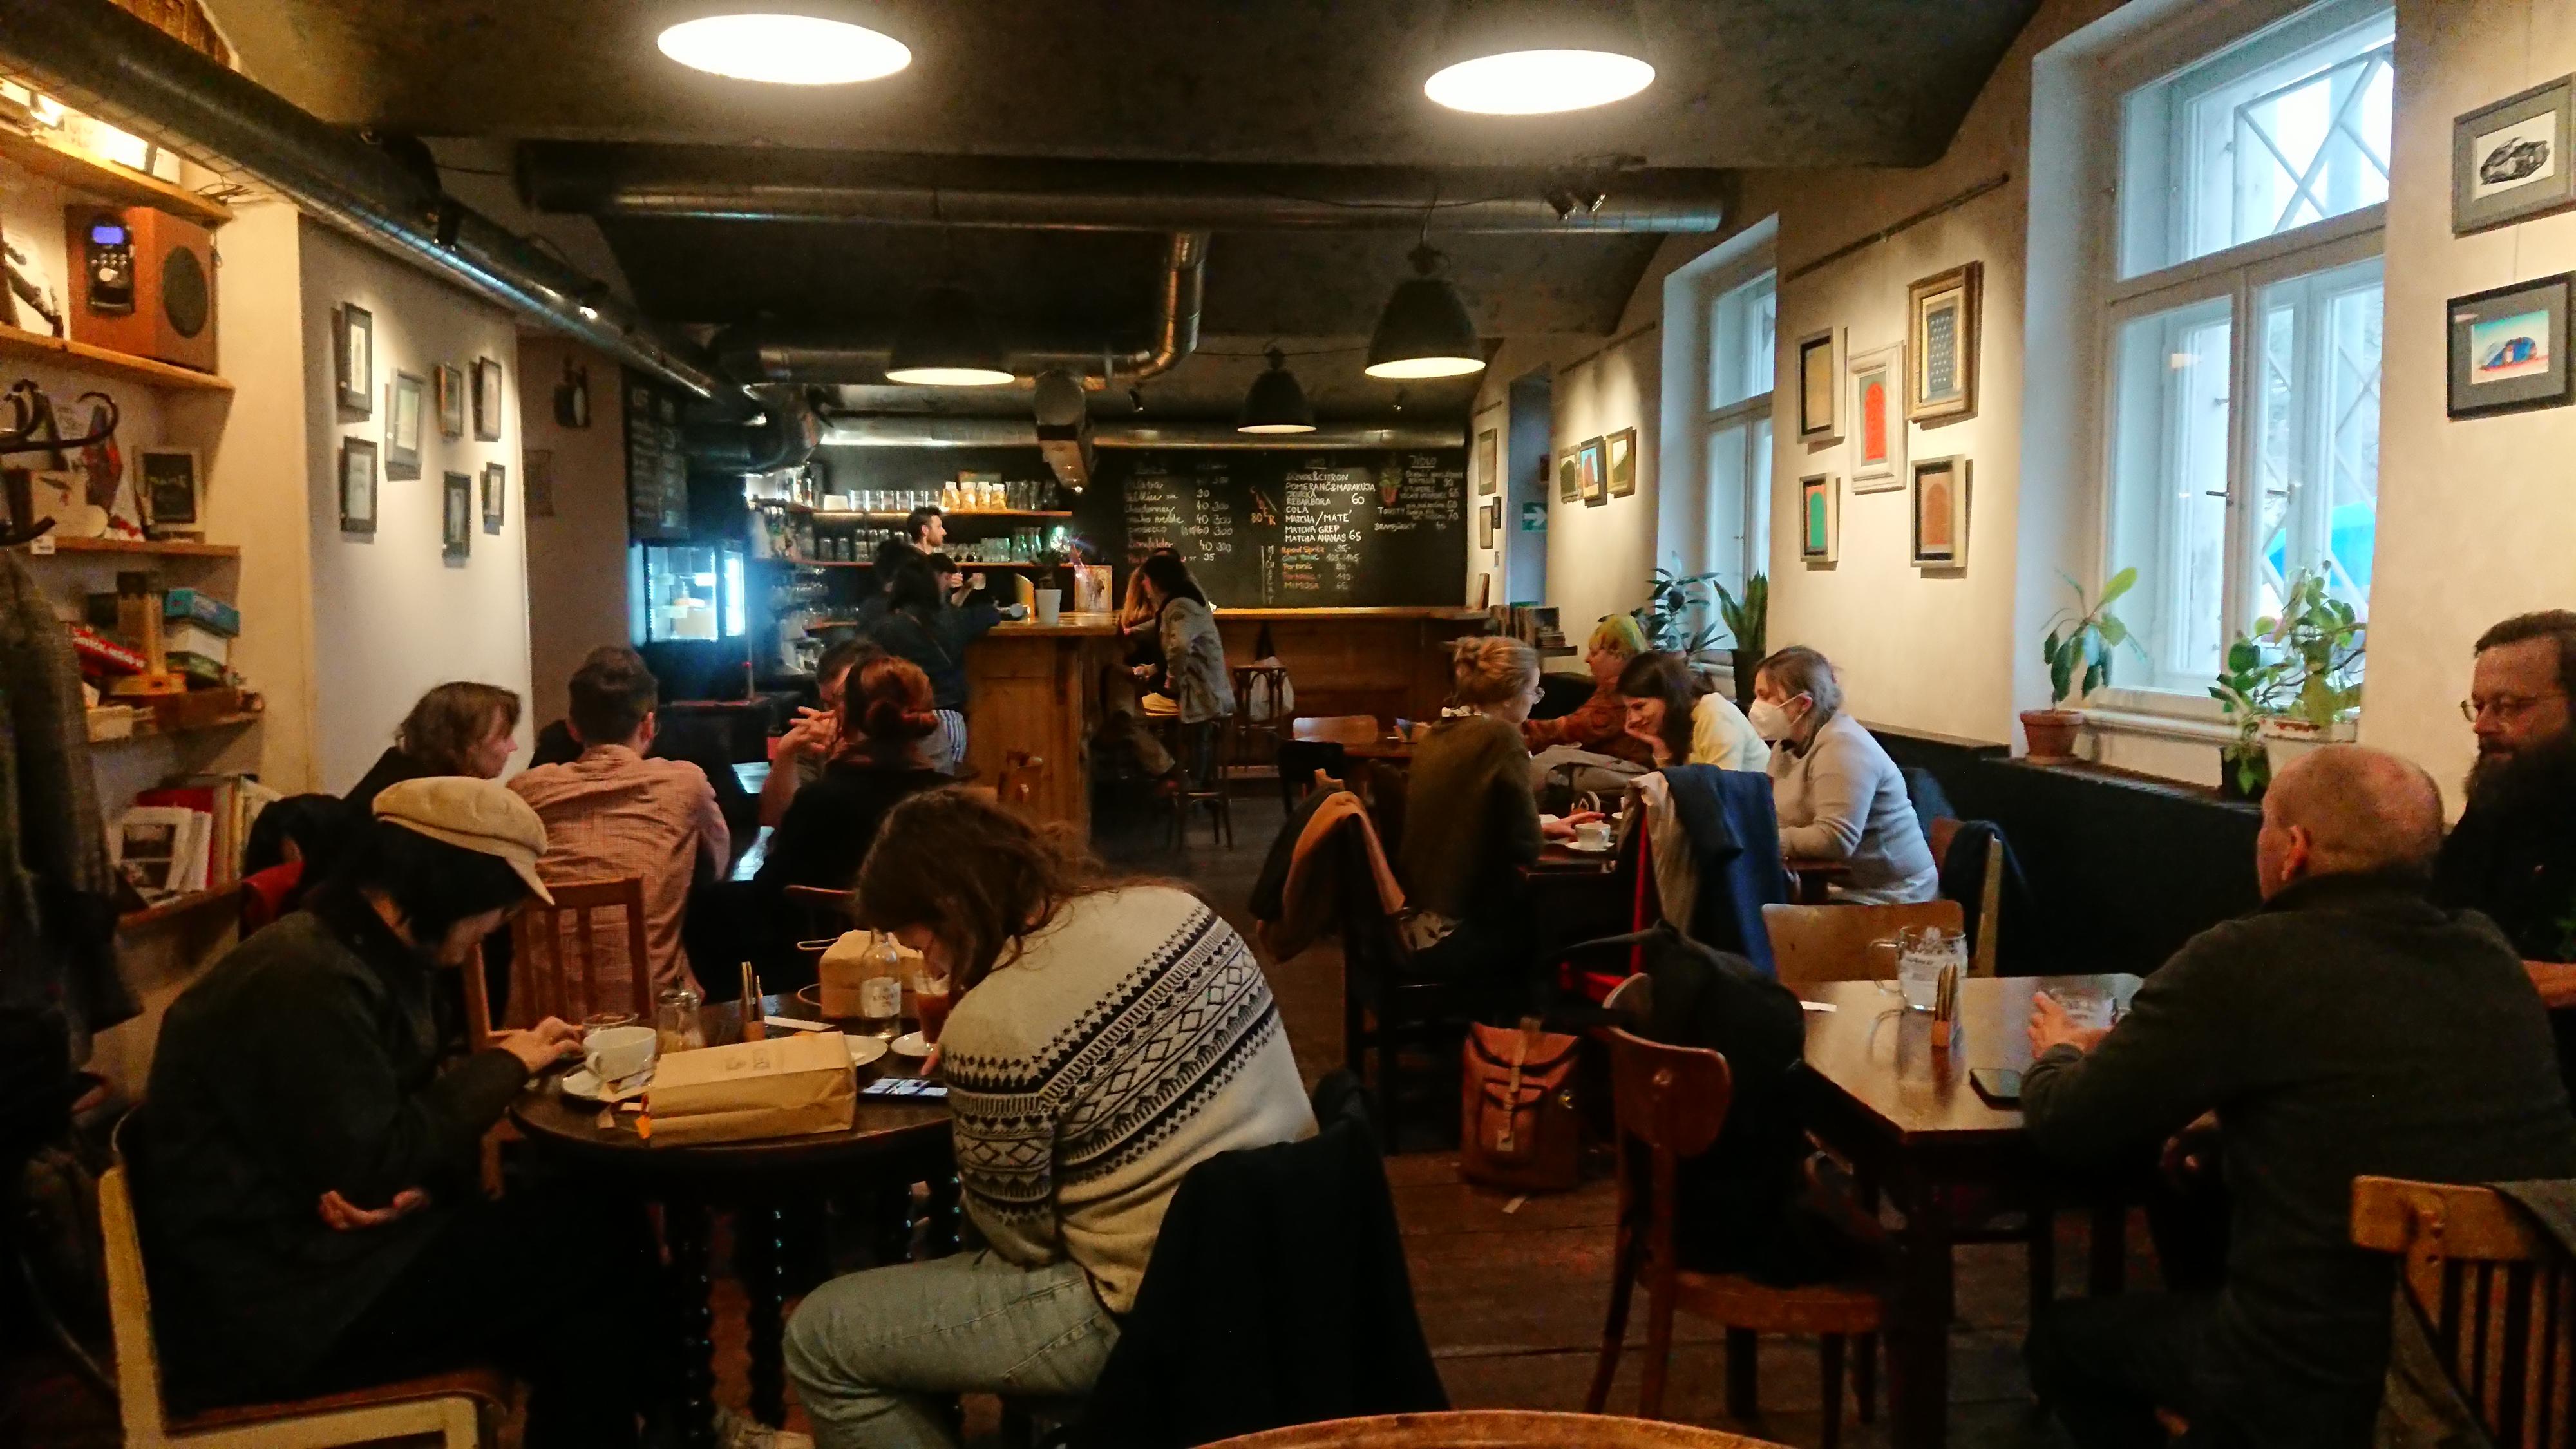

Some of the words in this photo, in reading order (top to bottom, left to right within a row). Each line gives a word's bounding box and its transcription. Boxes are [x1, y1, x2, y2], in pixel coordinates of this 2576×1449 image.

[1197, 489, 1210, 498] 30
[1351, 493, 1365, 504] 60
[1196, 500, 1210, 511] 40
[1211, 501, 1229, 512] 300
[1197, 513, 1209, 524] 40
[1213, 515, 1232, 525] 300
[1213, 527, 1233, 536] 300
[1285, 526, 1316, 534] MATCHA
[1318, 524, 1340, 533] GREP
[1317, 533, 1347, 542] ANANAS
[1349, 529, 1361, 542] 65
[1200, 540, 1212, 551] 40
[1216, 542, 1231, 553] 300
[1203, 553, 1215, 562] 35
